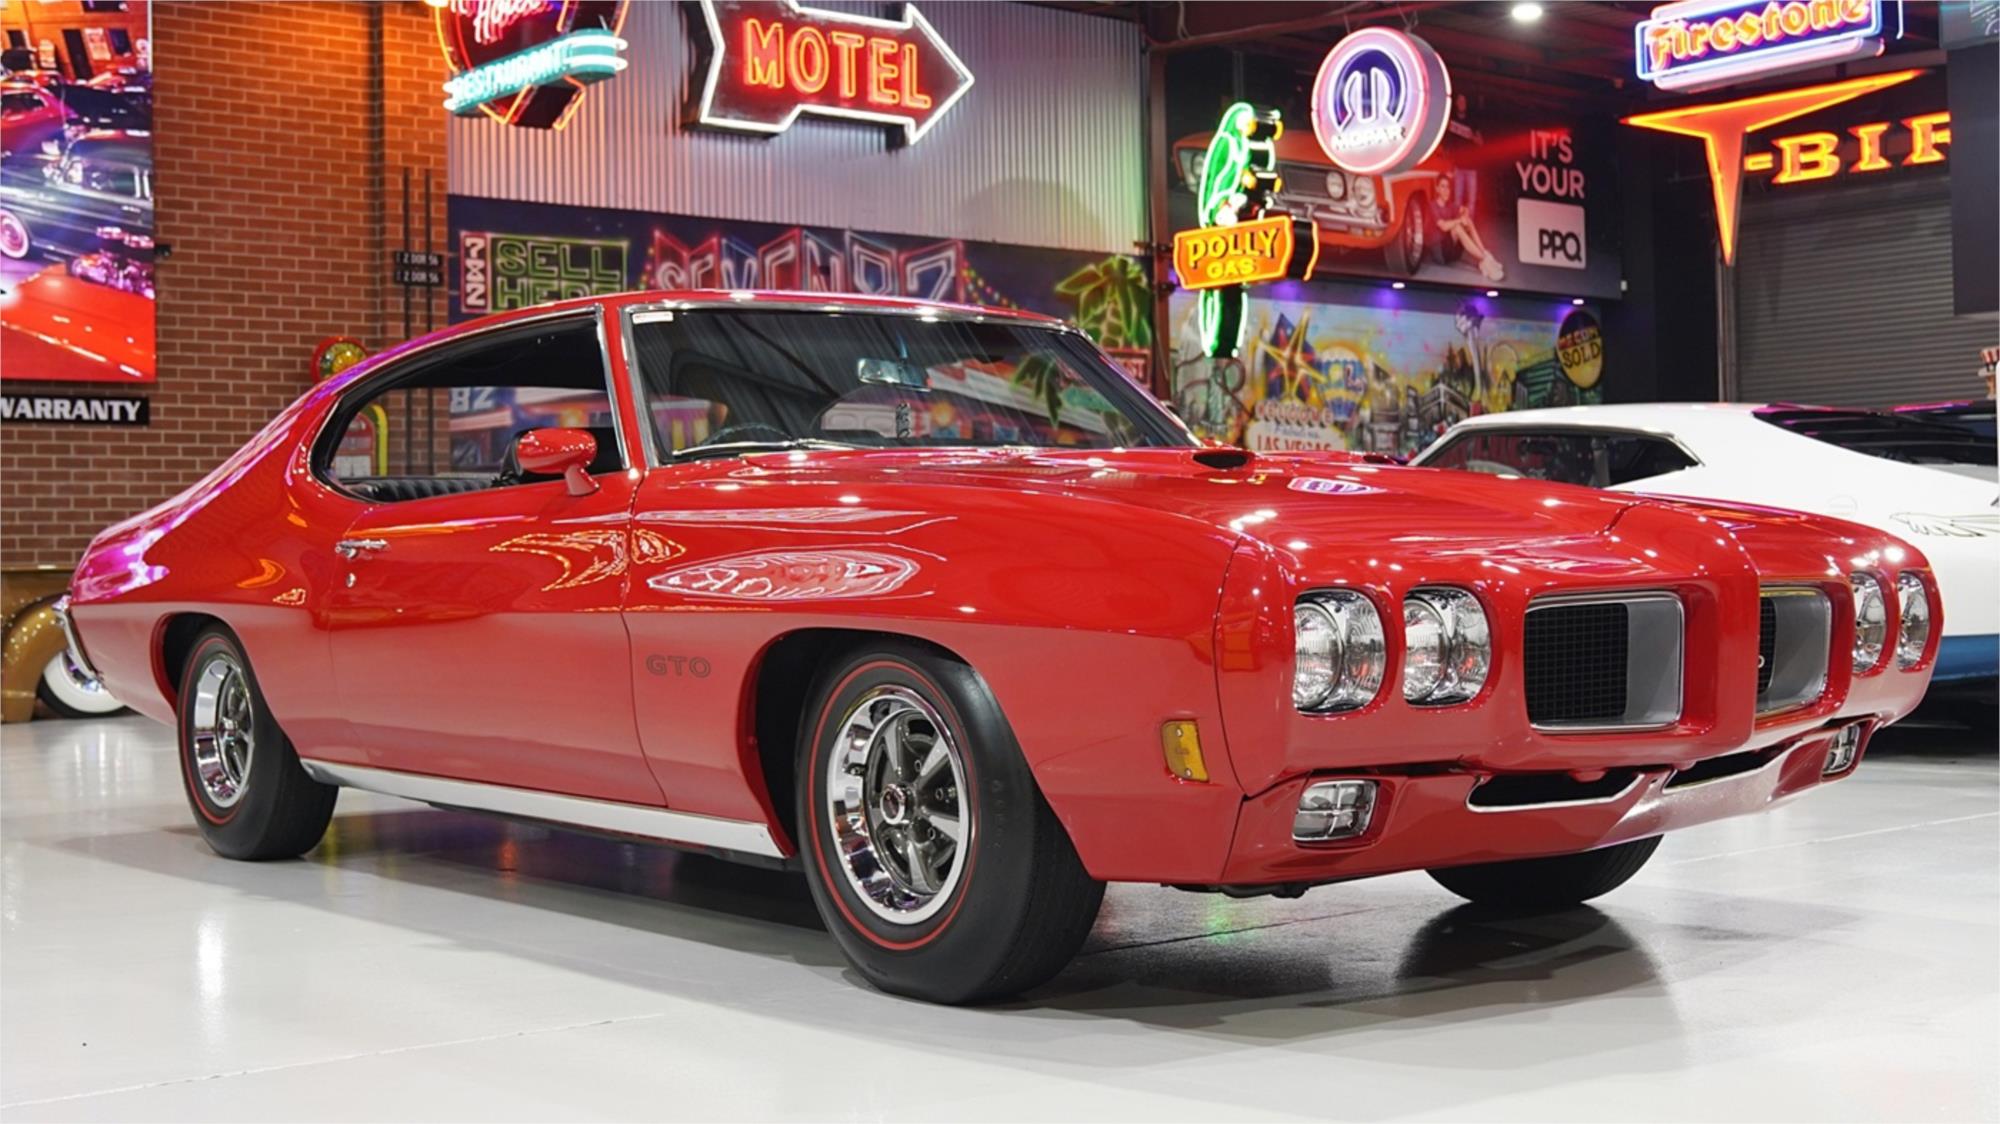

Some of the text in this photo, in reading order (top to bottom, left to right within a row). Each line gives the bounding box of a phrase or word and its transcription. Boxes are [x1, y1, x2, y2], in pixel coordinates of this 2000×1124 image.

[1648, 0, 1869, 71] Firestone
[745, 18, 931, 109] MOTEL
[1531, 129, 1573, 164] IT'S
[1516, 161, 1585, 199] YOUR
[496, 239, 621, 282] SELL
[1186, 228, 1279, 270] POLLY
[1539, 228, 1582, 262] PPQ
[1207, 257, 1257, 279] GAS
[1562, 341, 1601, 369] SOLD
[0, 397, 140, 421] WARRANTY
[646, 653, 711, 678] GTO
